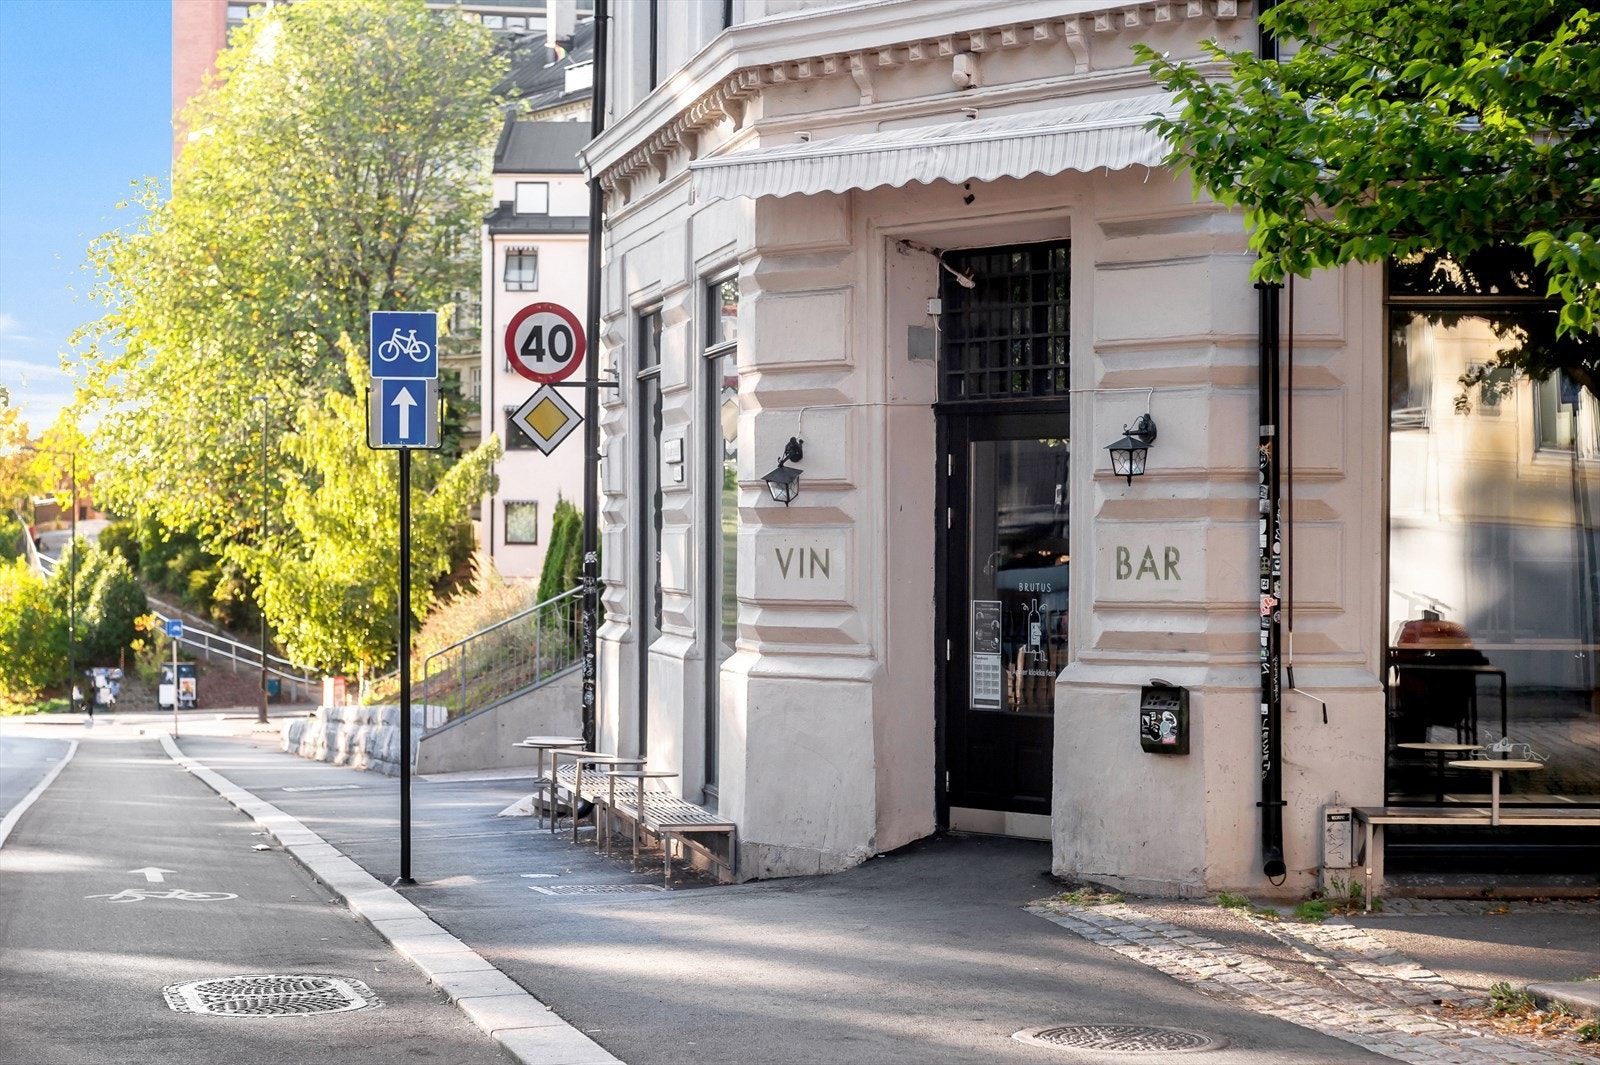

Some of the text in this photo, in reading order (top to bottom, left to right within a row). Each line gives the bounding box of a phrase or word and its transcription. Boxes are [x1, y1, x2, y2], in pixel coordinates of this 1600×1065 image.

[520, 324, 574, 363] 40
[775, 547, 830, 580] VIN
[1116, 545, 1181, 581] BAR
[1018, 582, 1052, 593] BRUTUS
[1028, 668, 1046, 677] klokka
